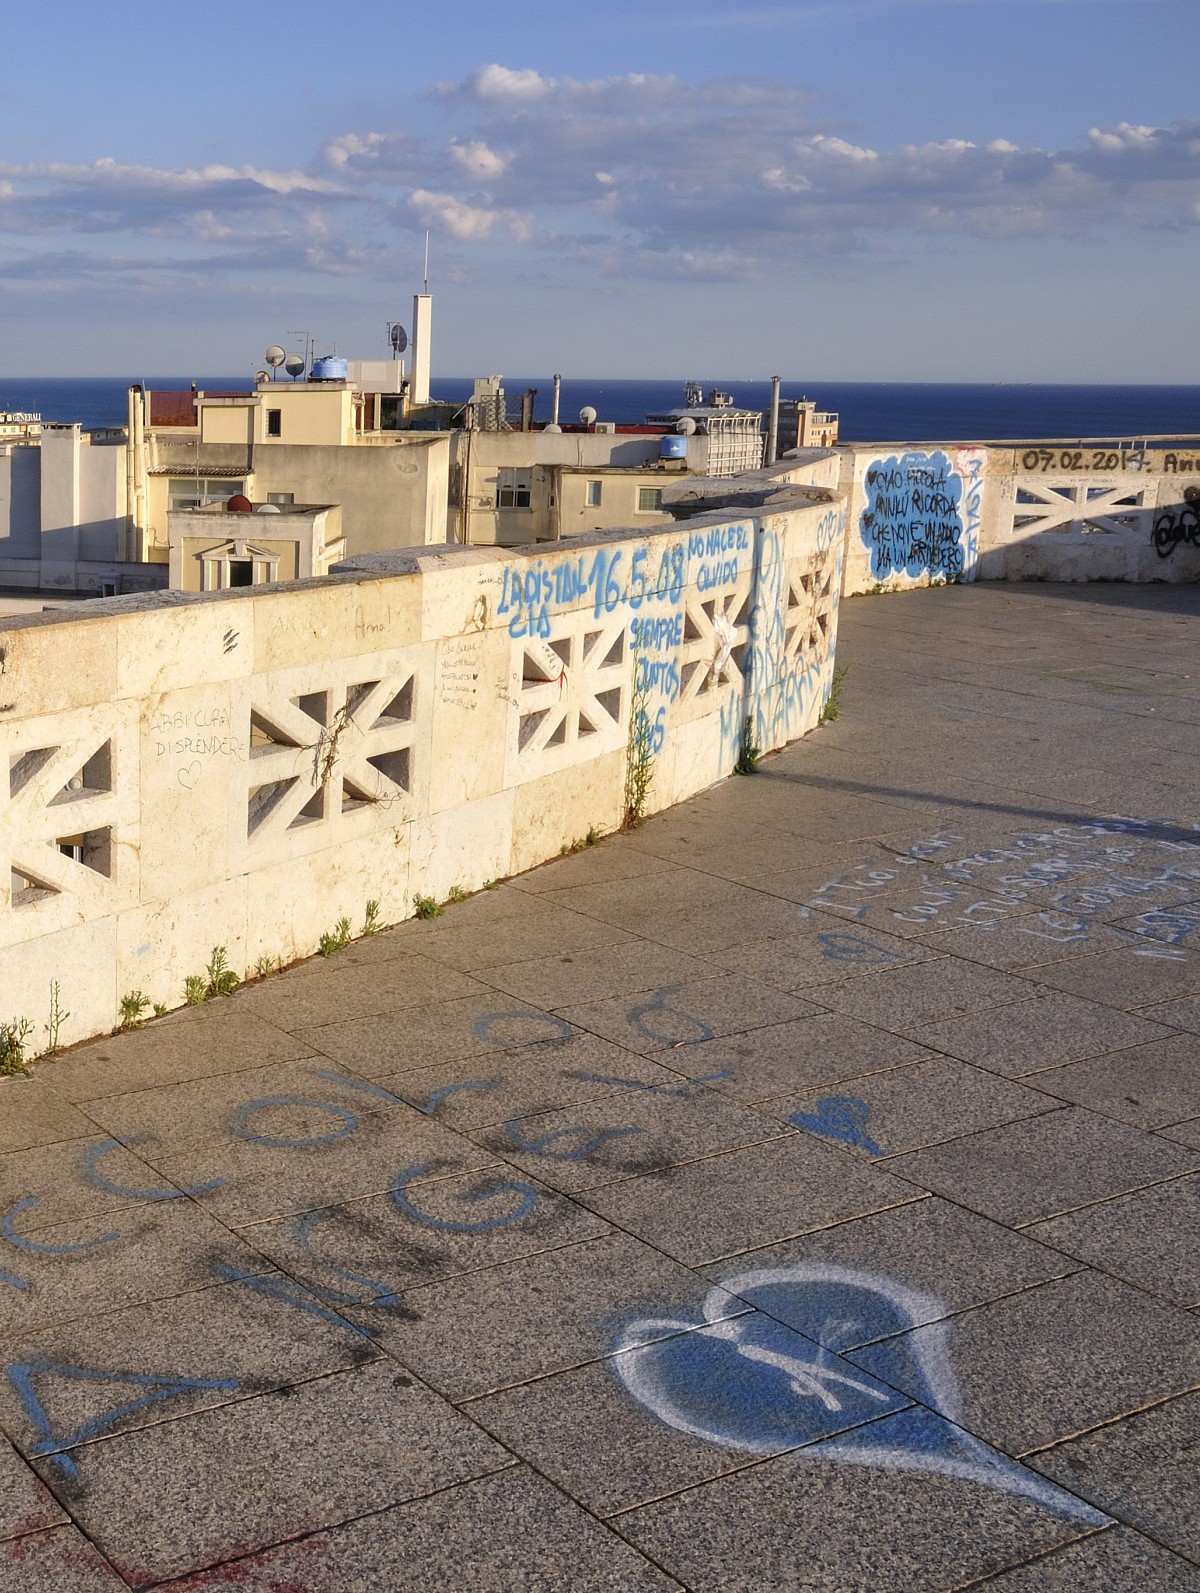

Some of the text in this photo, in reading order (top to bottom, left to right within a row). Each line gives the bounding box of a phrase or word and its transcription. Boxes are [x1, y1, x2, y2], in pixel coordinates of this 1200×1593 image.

[12, 412, 41, 421] GENERALI
[876, 469, 902, 492] CIAO
[912, 489, 957, 520] RICORDA
[697, 557, 738, 593] OLVIDO
[630, 613, 682, 652] SIEMPRE
[637, 656, 680, 705] JUNTOS
[194, 708, 231, 729] CURA
[156, 735, 248, 761] DI SPLENDERE
